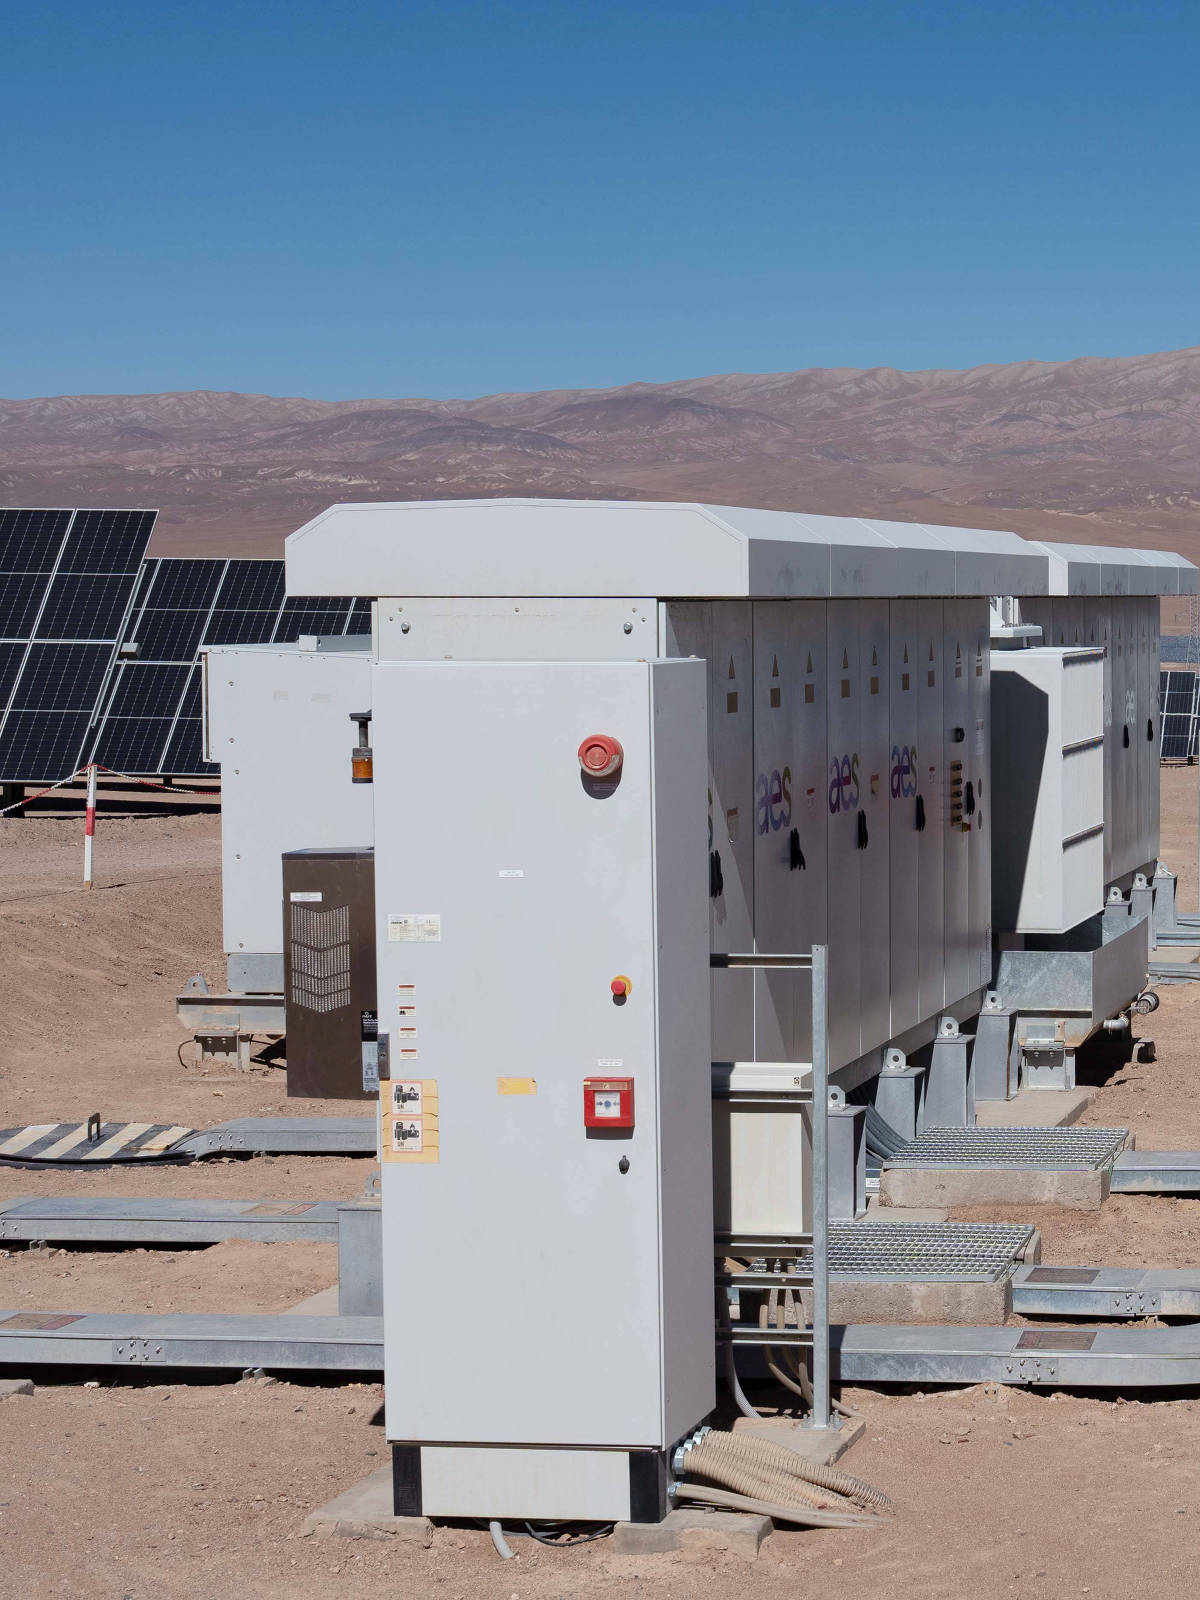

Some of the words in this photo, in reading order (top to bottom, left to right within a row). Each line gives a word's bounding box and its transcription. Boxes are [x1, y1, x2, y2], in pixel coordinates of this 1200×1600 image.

[756, 766, 792, 836] aes
[829, 752, 860, 814] aes
[891, 745, 918, 799] aes
